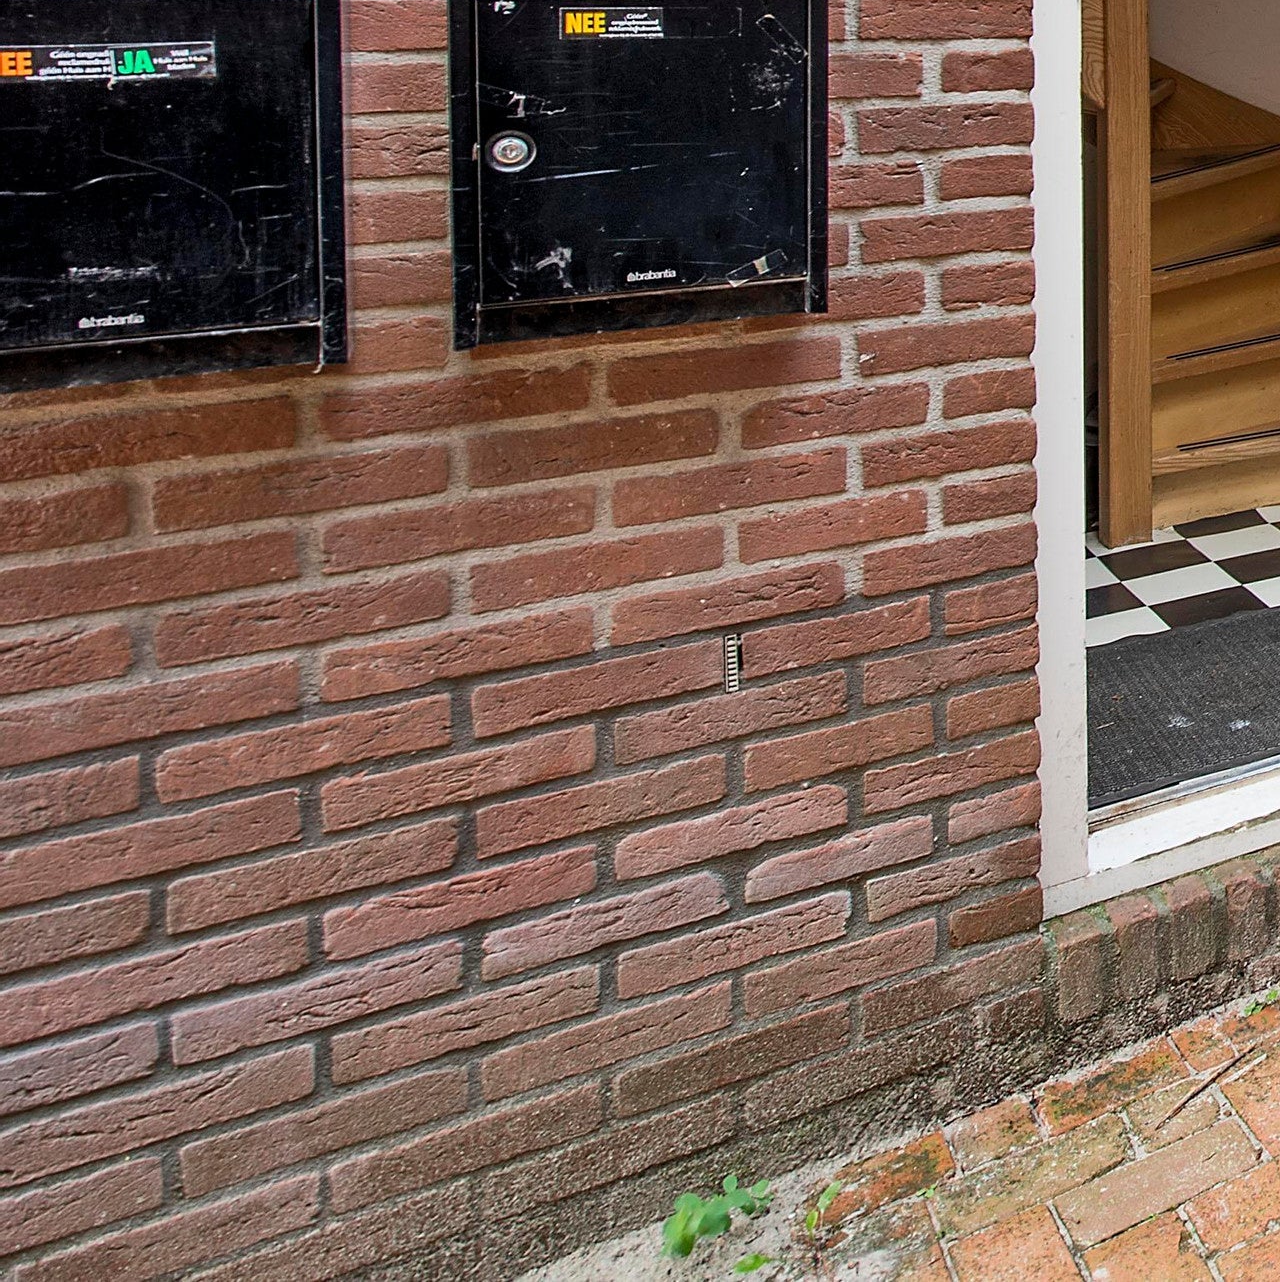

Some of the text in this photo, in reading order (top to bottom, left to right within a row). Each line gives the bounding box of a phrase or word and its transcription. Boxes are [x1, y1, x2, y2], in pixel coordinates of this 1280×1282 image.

[565, 12, 606, 34] NEE
[0, 51, 33, 76] EE
[117, 50, 156, 74] JA
[634, 268, 677, 281] brabantia
[89, 312, 145, 327] brabantia
